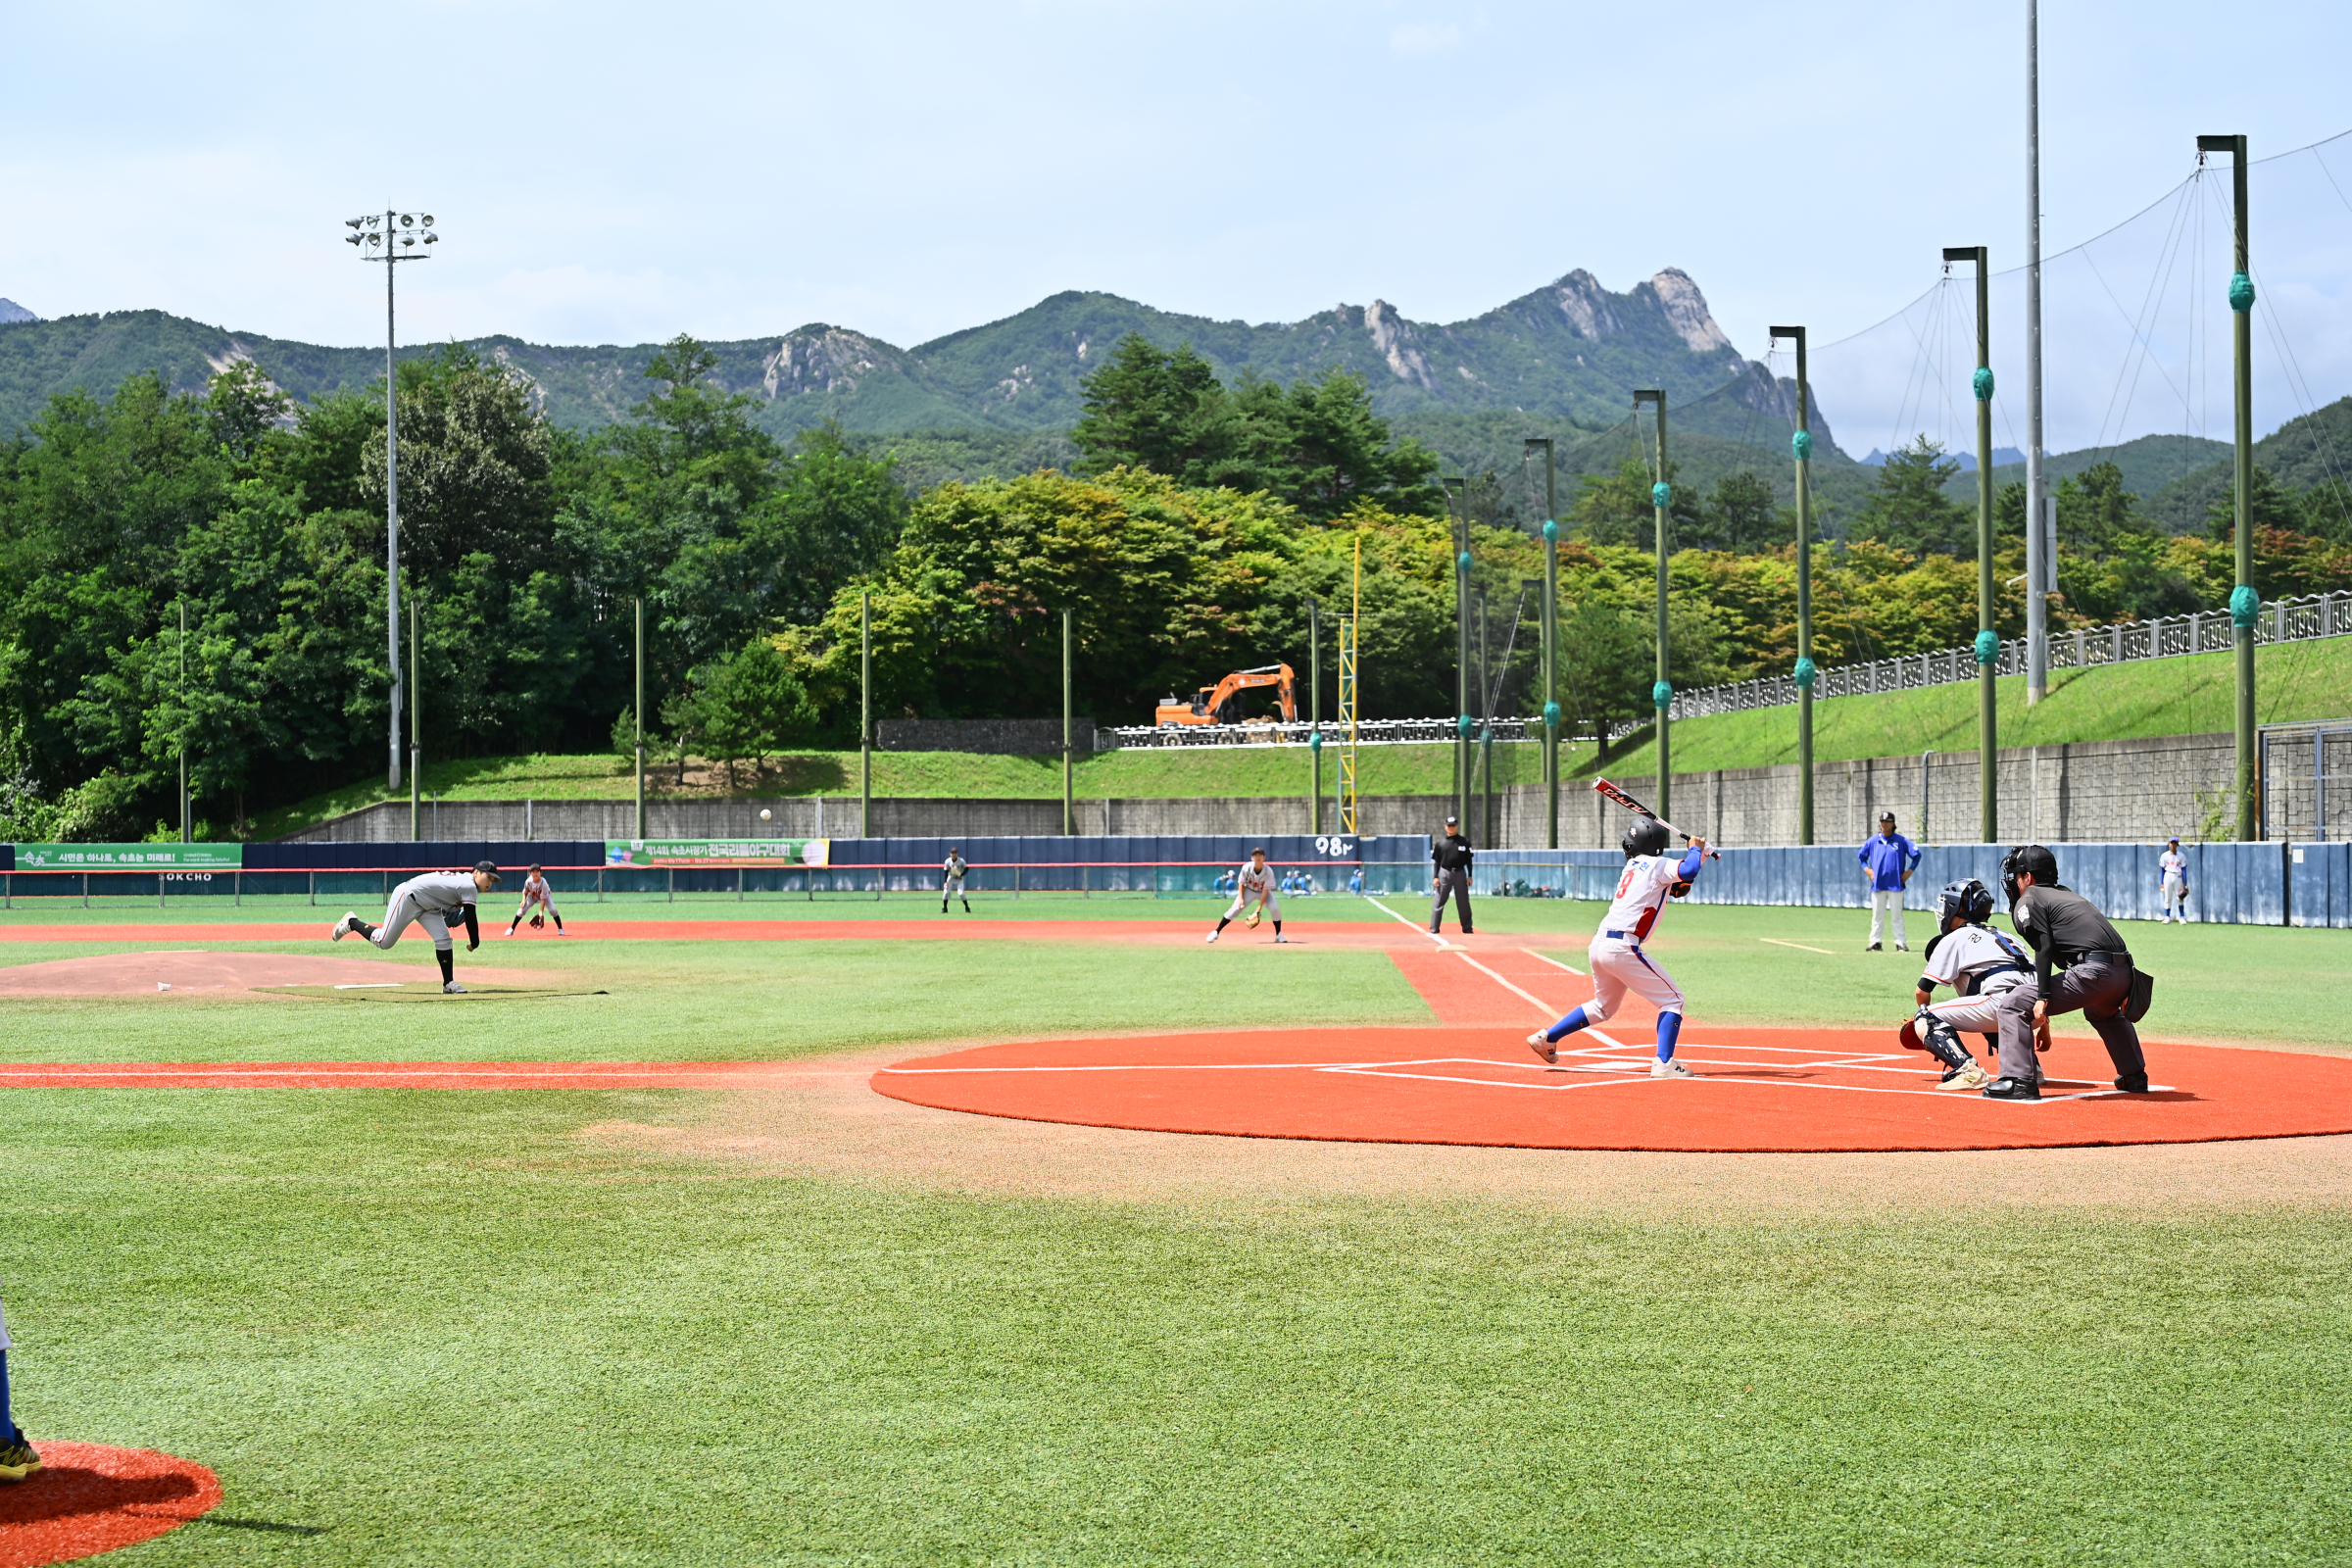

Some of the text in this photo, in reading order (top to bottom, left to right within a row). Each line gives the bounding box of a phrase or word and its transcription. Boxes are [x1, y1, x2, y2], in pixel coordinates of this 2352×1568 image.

[645, 843, 790, 857] 제14회 속초시장기 전국리틀야구대회
[59, 853, 84, 862] 시민은
[86, 853, 116, 863] 하나로,
[119, 853, 144, 862] 속초는
[147, 853, 175, 862] 미래로!
[1615, 871, 1635, 900] 9
